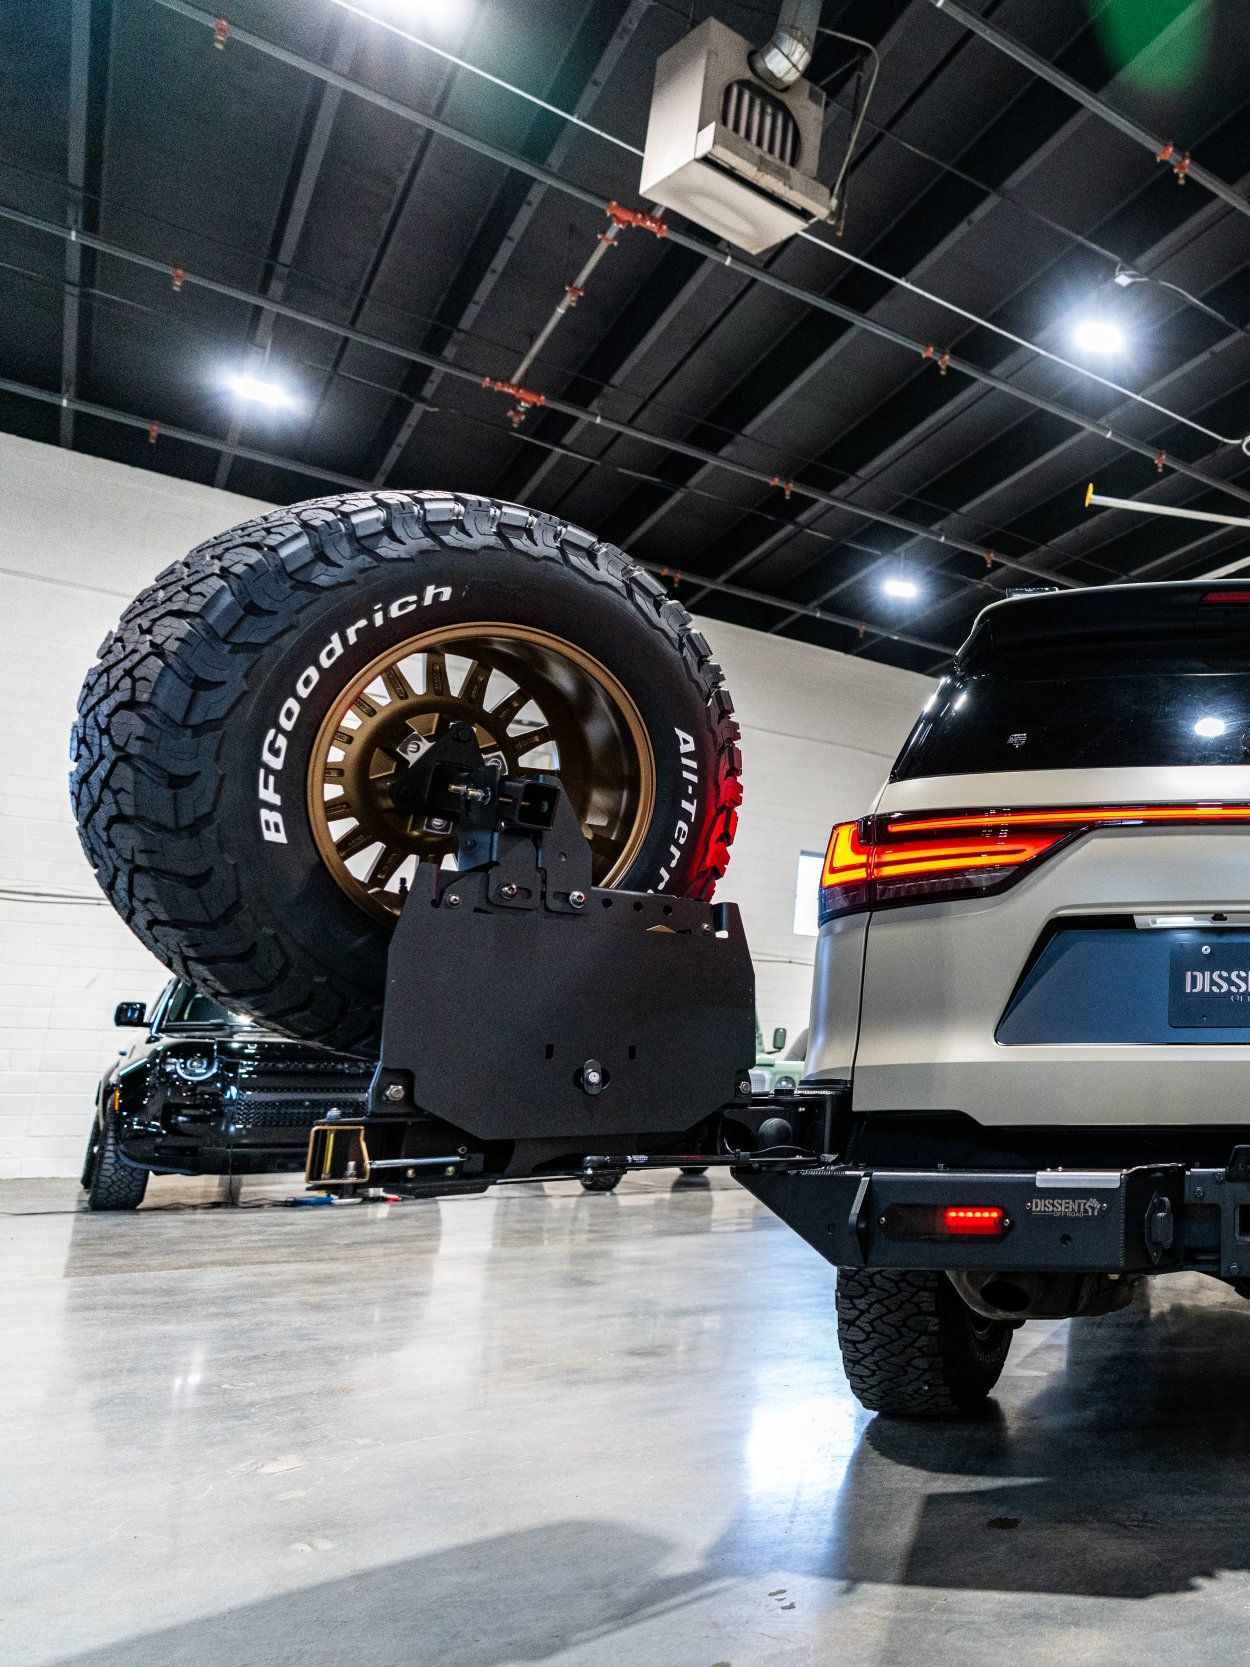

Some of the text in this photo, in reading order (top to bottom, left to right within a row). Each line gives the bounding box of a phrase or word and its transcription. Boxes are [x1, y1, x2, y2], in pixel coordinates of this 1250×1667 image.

[258, 584, 452, 844] BFGoodrich
[646, 727, 699, 894] All-Terr
[1031, 1198, 1087, 1212] DISSENT
